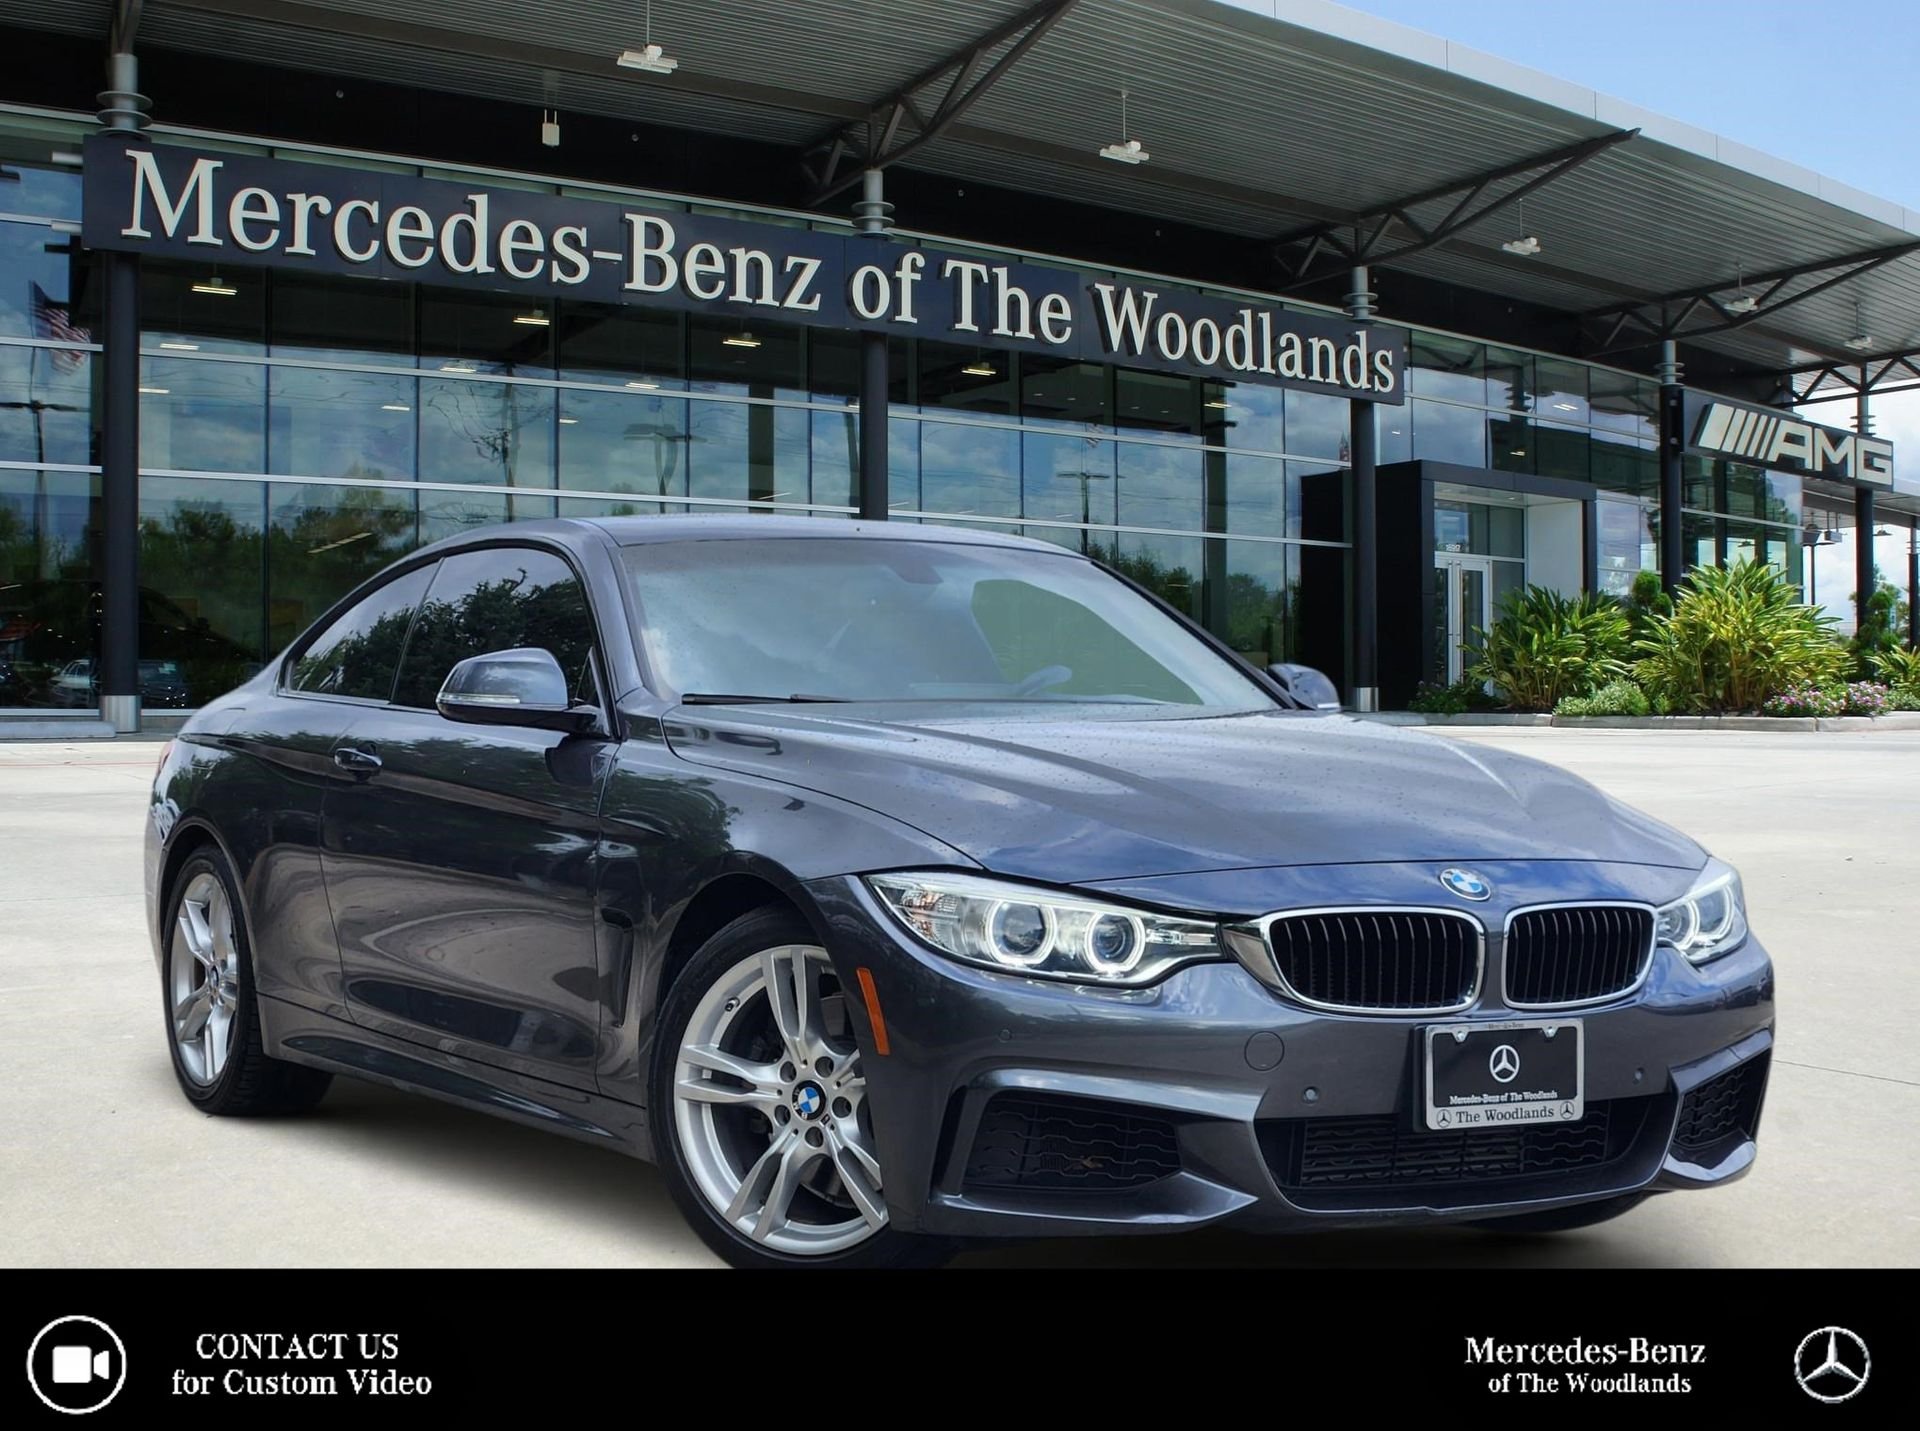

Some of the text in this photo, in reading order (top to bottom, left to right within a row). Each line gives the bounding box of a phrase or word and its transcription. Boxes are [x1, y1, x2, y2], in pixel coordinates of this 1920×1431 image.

[121, 149, 1395, 394] Mercedes-Benz of The Woodlands
[1766, 418, 1894, 486] AMG
[1456, 1103, 1555, 1124] The Woodlands
[1510, 1091, 1523, 1102] The
[1523, 1089, 1559, 1101] Woodlands
